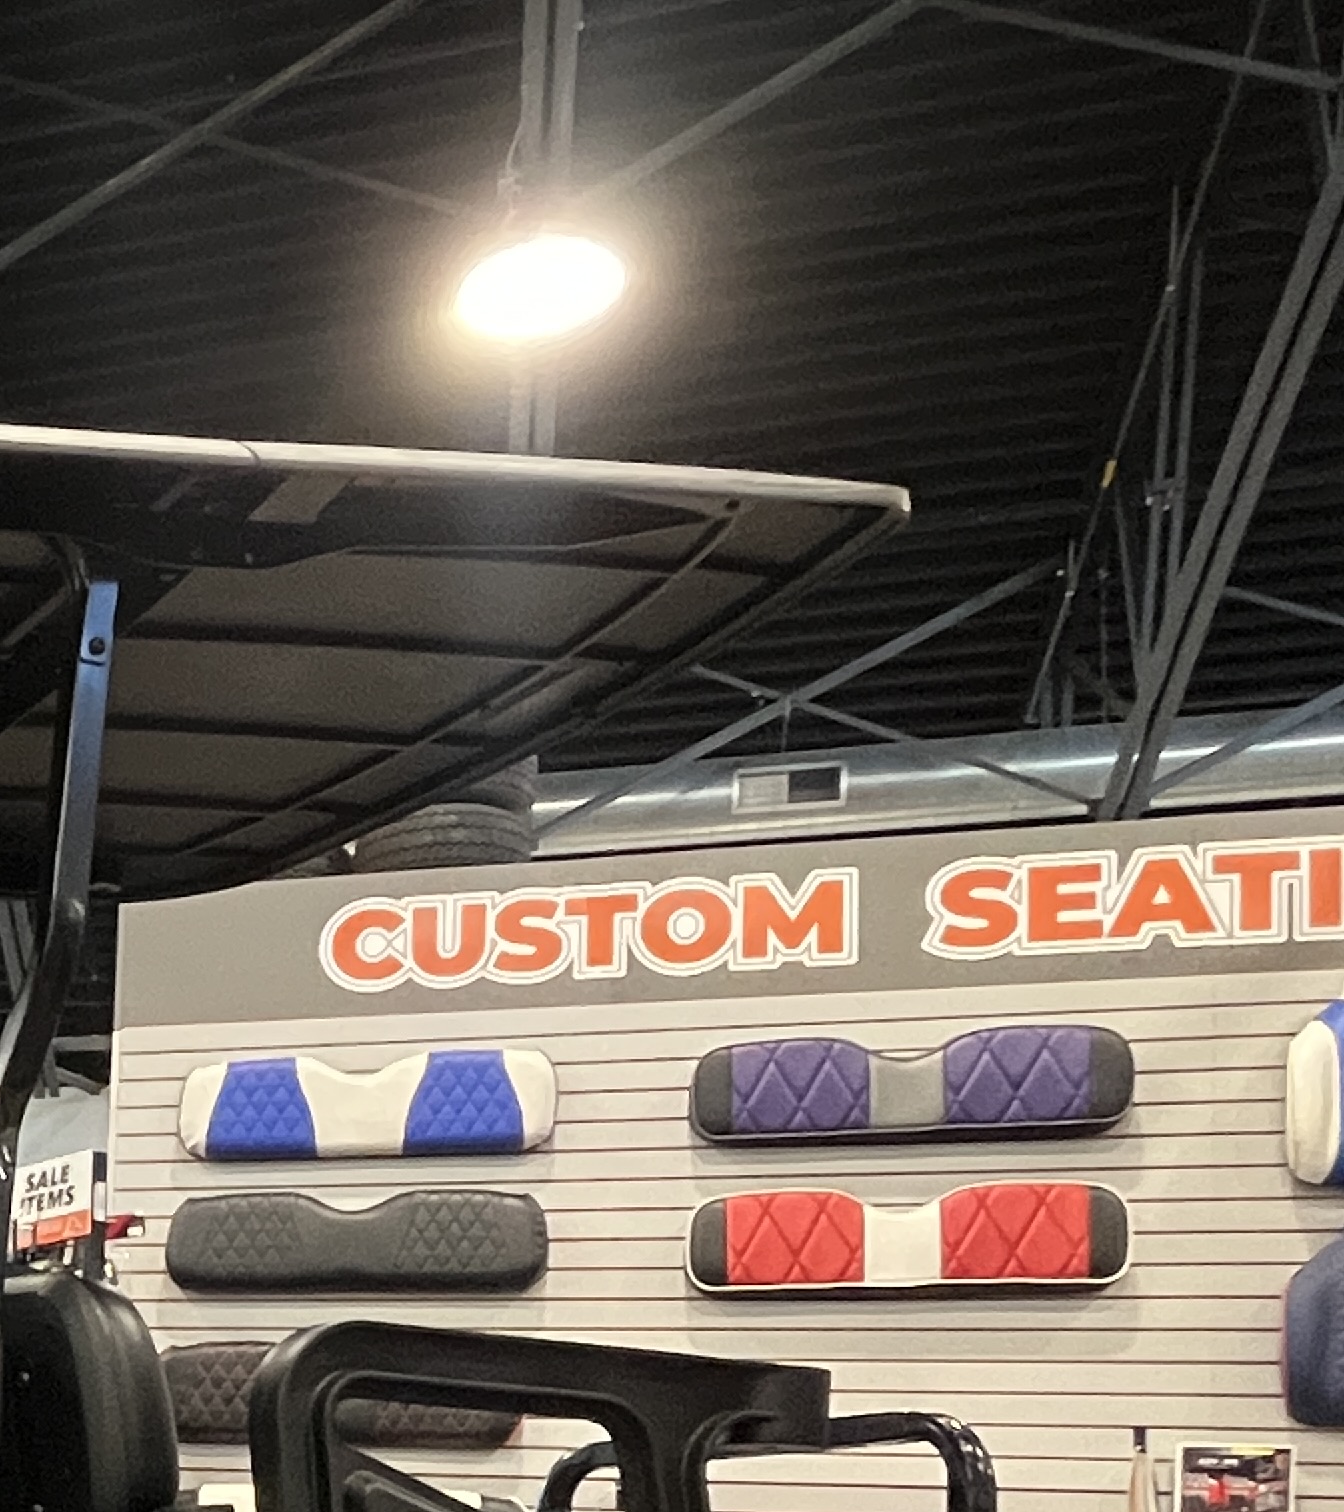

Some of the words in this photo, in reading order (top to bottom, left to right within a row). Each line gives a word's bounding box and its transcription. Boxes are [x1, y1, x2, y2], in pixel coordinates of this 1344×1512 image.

[324, 873, 852, 986] CUSTOM
[930, 842, 1343, 953] SEATI
[24, 1164, 70, 1194] SALE
[18, 1185, 76, 1218] ITEMS
